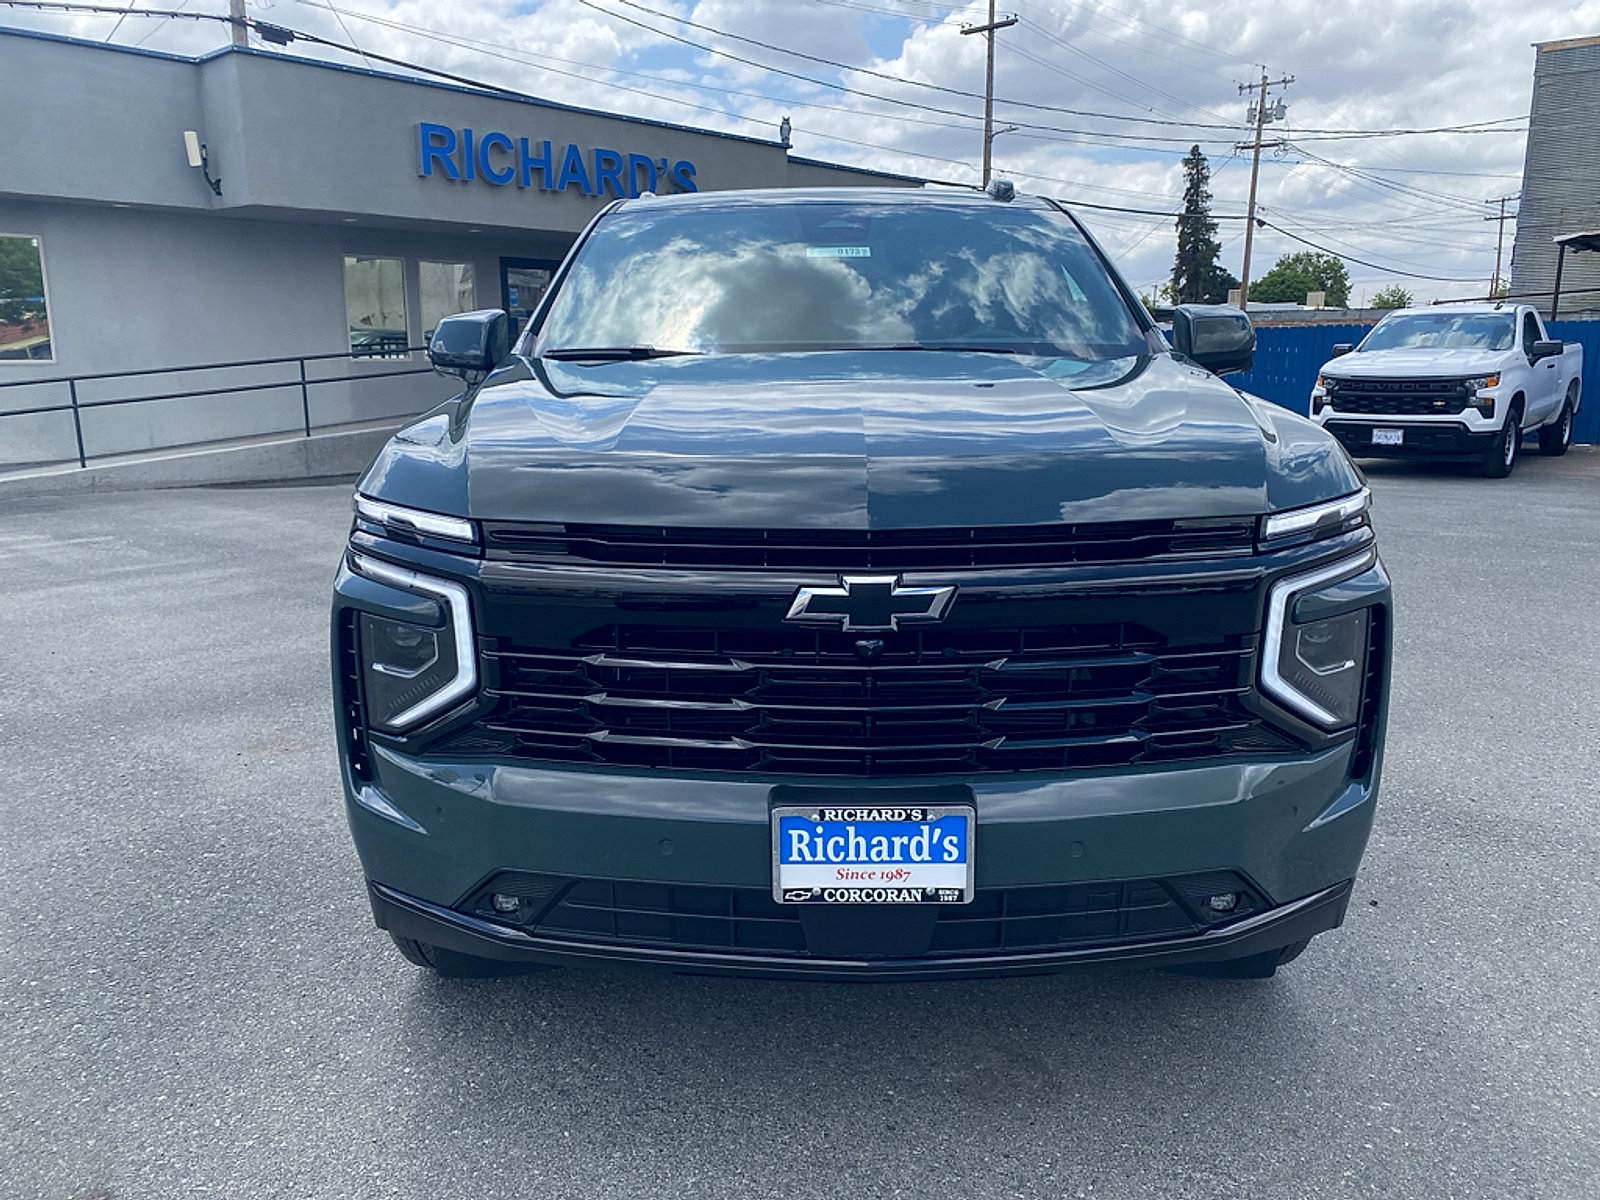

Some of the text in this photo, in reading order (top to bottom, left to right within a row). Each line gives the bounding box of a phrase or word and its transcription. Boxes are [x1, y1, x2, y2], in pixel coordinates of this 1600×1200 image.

[416, 121, 698, 199] RICHARD'S
[824, 809, 922, 821] RICHARD'S
[788, 826, 959, 862] Richard's
[835, 868, 911, 882] Since 1987
[823, 889, 923, 902] CORCORAN
